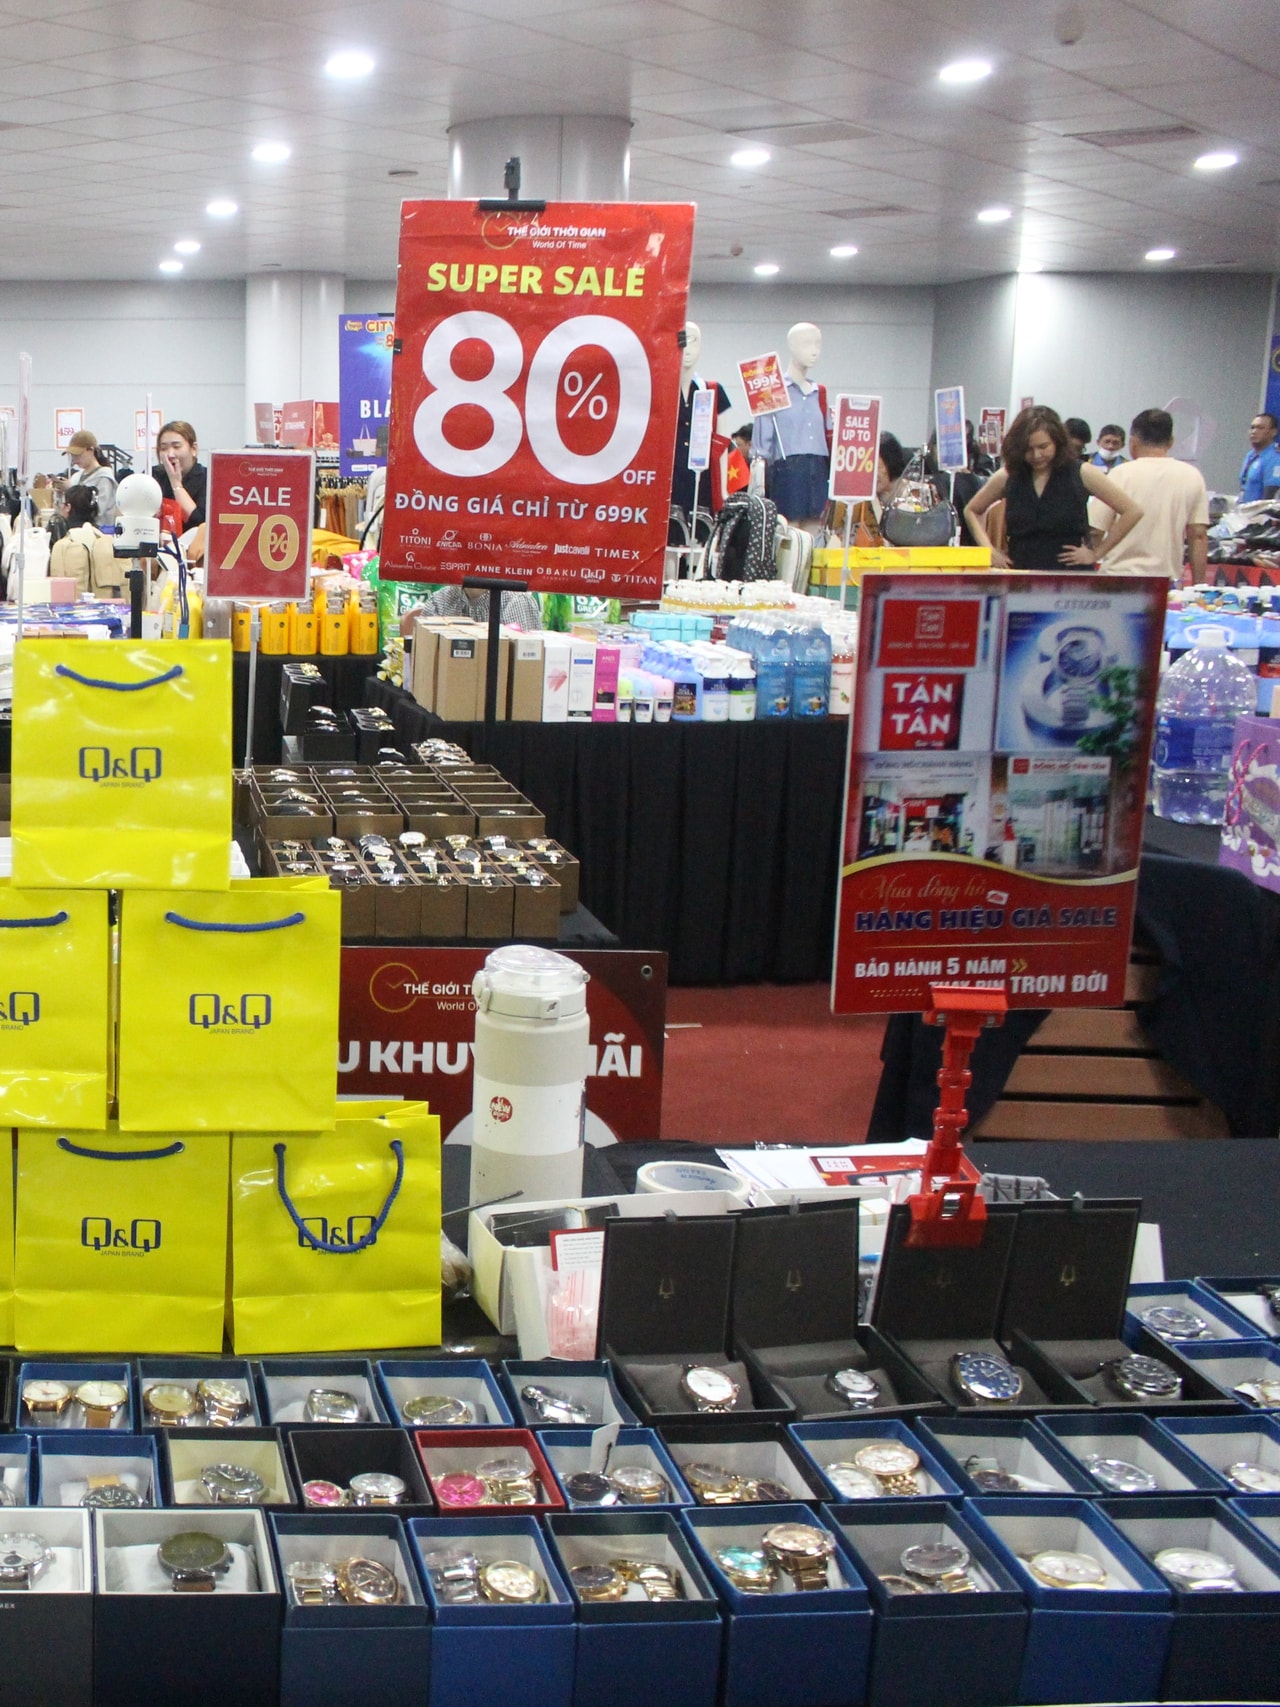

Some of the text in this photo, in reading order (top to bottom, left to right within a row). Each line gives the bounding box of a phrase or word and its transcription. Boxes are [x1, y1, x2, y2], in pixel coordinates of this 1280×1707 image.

[580, 227, 607, 238] GIAN
[532, 240, 587, 249] World Of Time
[427, 261, 646, 298] SUPER SALE
[747, 373, 781, 391] 199K
[360, 399, 392, 419] BLA
[845, 415, 870, 429] SALE
[842, 429, 871, 442] UP TO
[835, 445, 874, 473] 80%
[623, 469, 657, 487] OFF
[228, 486, 292, 507] SALE
[395, 489, 649, 525] ĐỒNG GIÁ CHỈ TỪ 699K
[400, 535, 431, 545] TITONI
[467, 541, 503, 551] BONIA
[595, 547, 641, 560] TIMEX
[440, 561, 471, 571] ESPRIT
[475, 563, 533, 576] ANNE KLEIN
[536, 566, 577, 577] OBAKU
[624, 574, 657, 585] TITAN
[891, 676, 954, 704] TÂN
[890, 706, 951, 735] TÂN
[79, 746, 162, 782] Q&Q
[855, 905, 1119, 933] HÀNG HIỆU GIÁ SALE
[855, 957, 1006, 978] BẢO HÀNH 5 NĂM
[403, 981, 430, 995] THẾ
[432, 981, 460, 995] GIỚI
[1010, 974, 1066, 997] TRỌN
[1071, 970, 1109, 993] ĐỜI
[189, 994, 272, 1029] Q&Q
[437, 1001, 465, 1011] World
[370, 1041, 475, 1075] KHU
[587, 1032, 642, 1077] ÃI
[82, 1217, 161, 1252] Q&Q
[122, 1250, 144, 1258] BRAND
